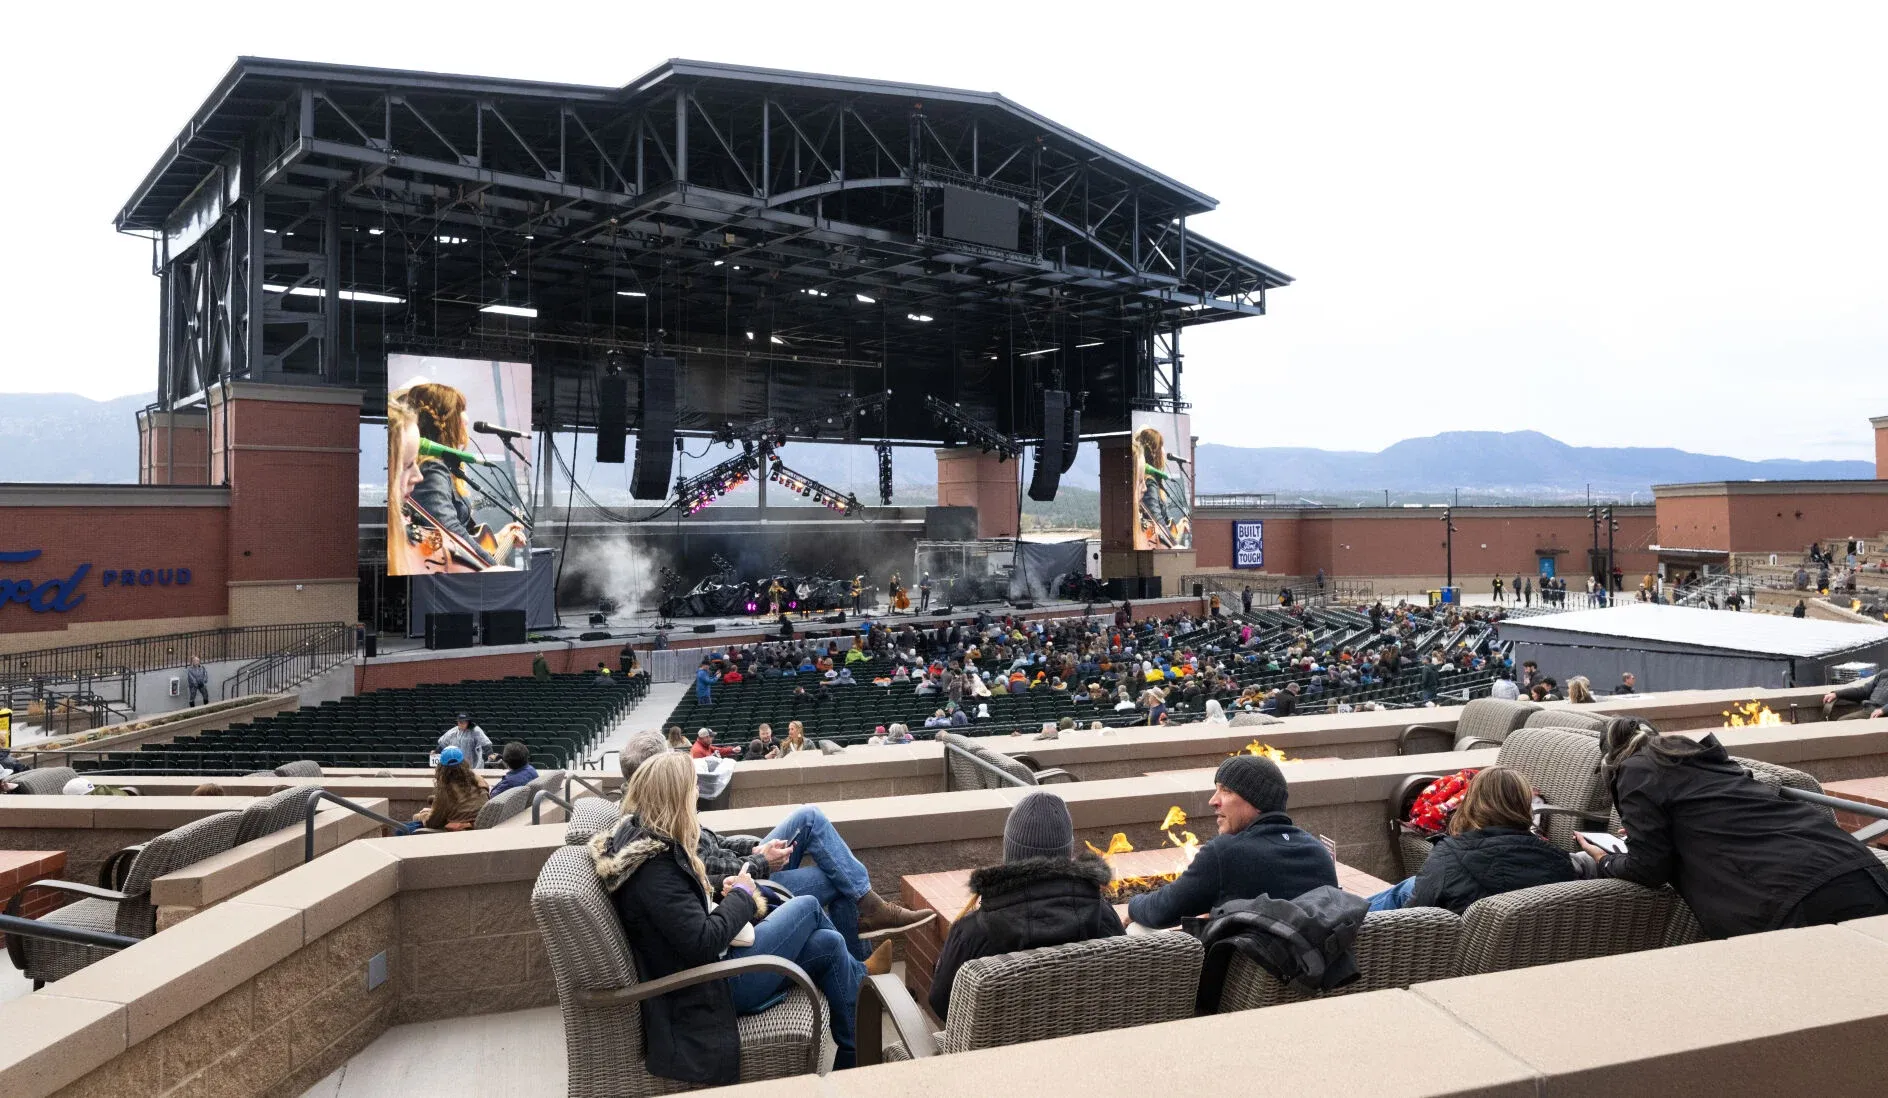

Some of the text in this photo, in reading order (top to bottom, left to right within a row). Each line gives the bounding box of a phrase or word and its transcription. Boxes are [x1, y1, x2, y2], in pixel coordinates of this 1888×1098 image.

[1239, 525, 1261, 537] BUILT
[1239, 553, 1261, 563] TOUGH
[102, 568, 192, 587] PROUD
